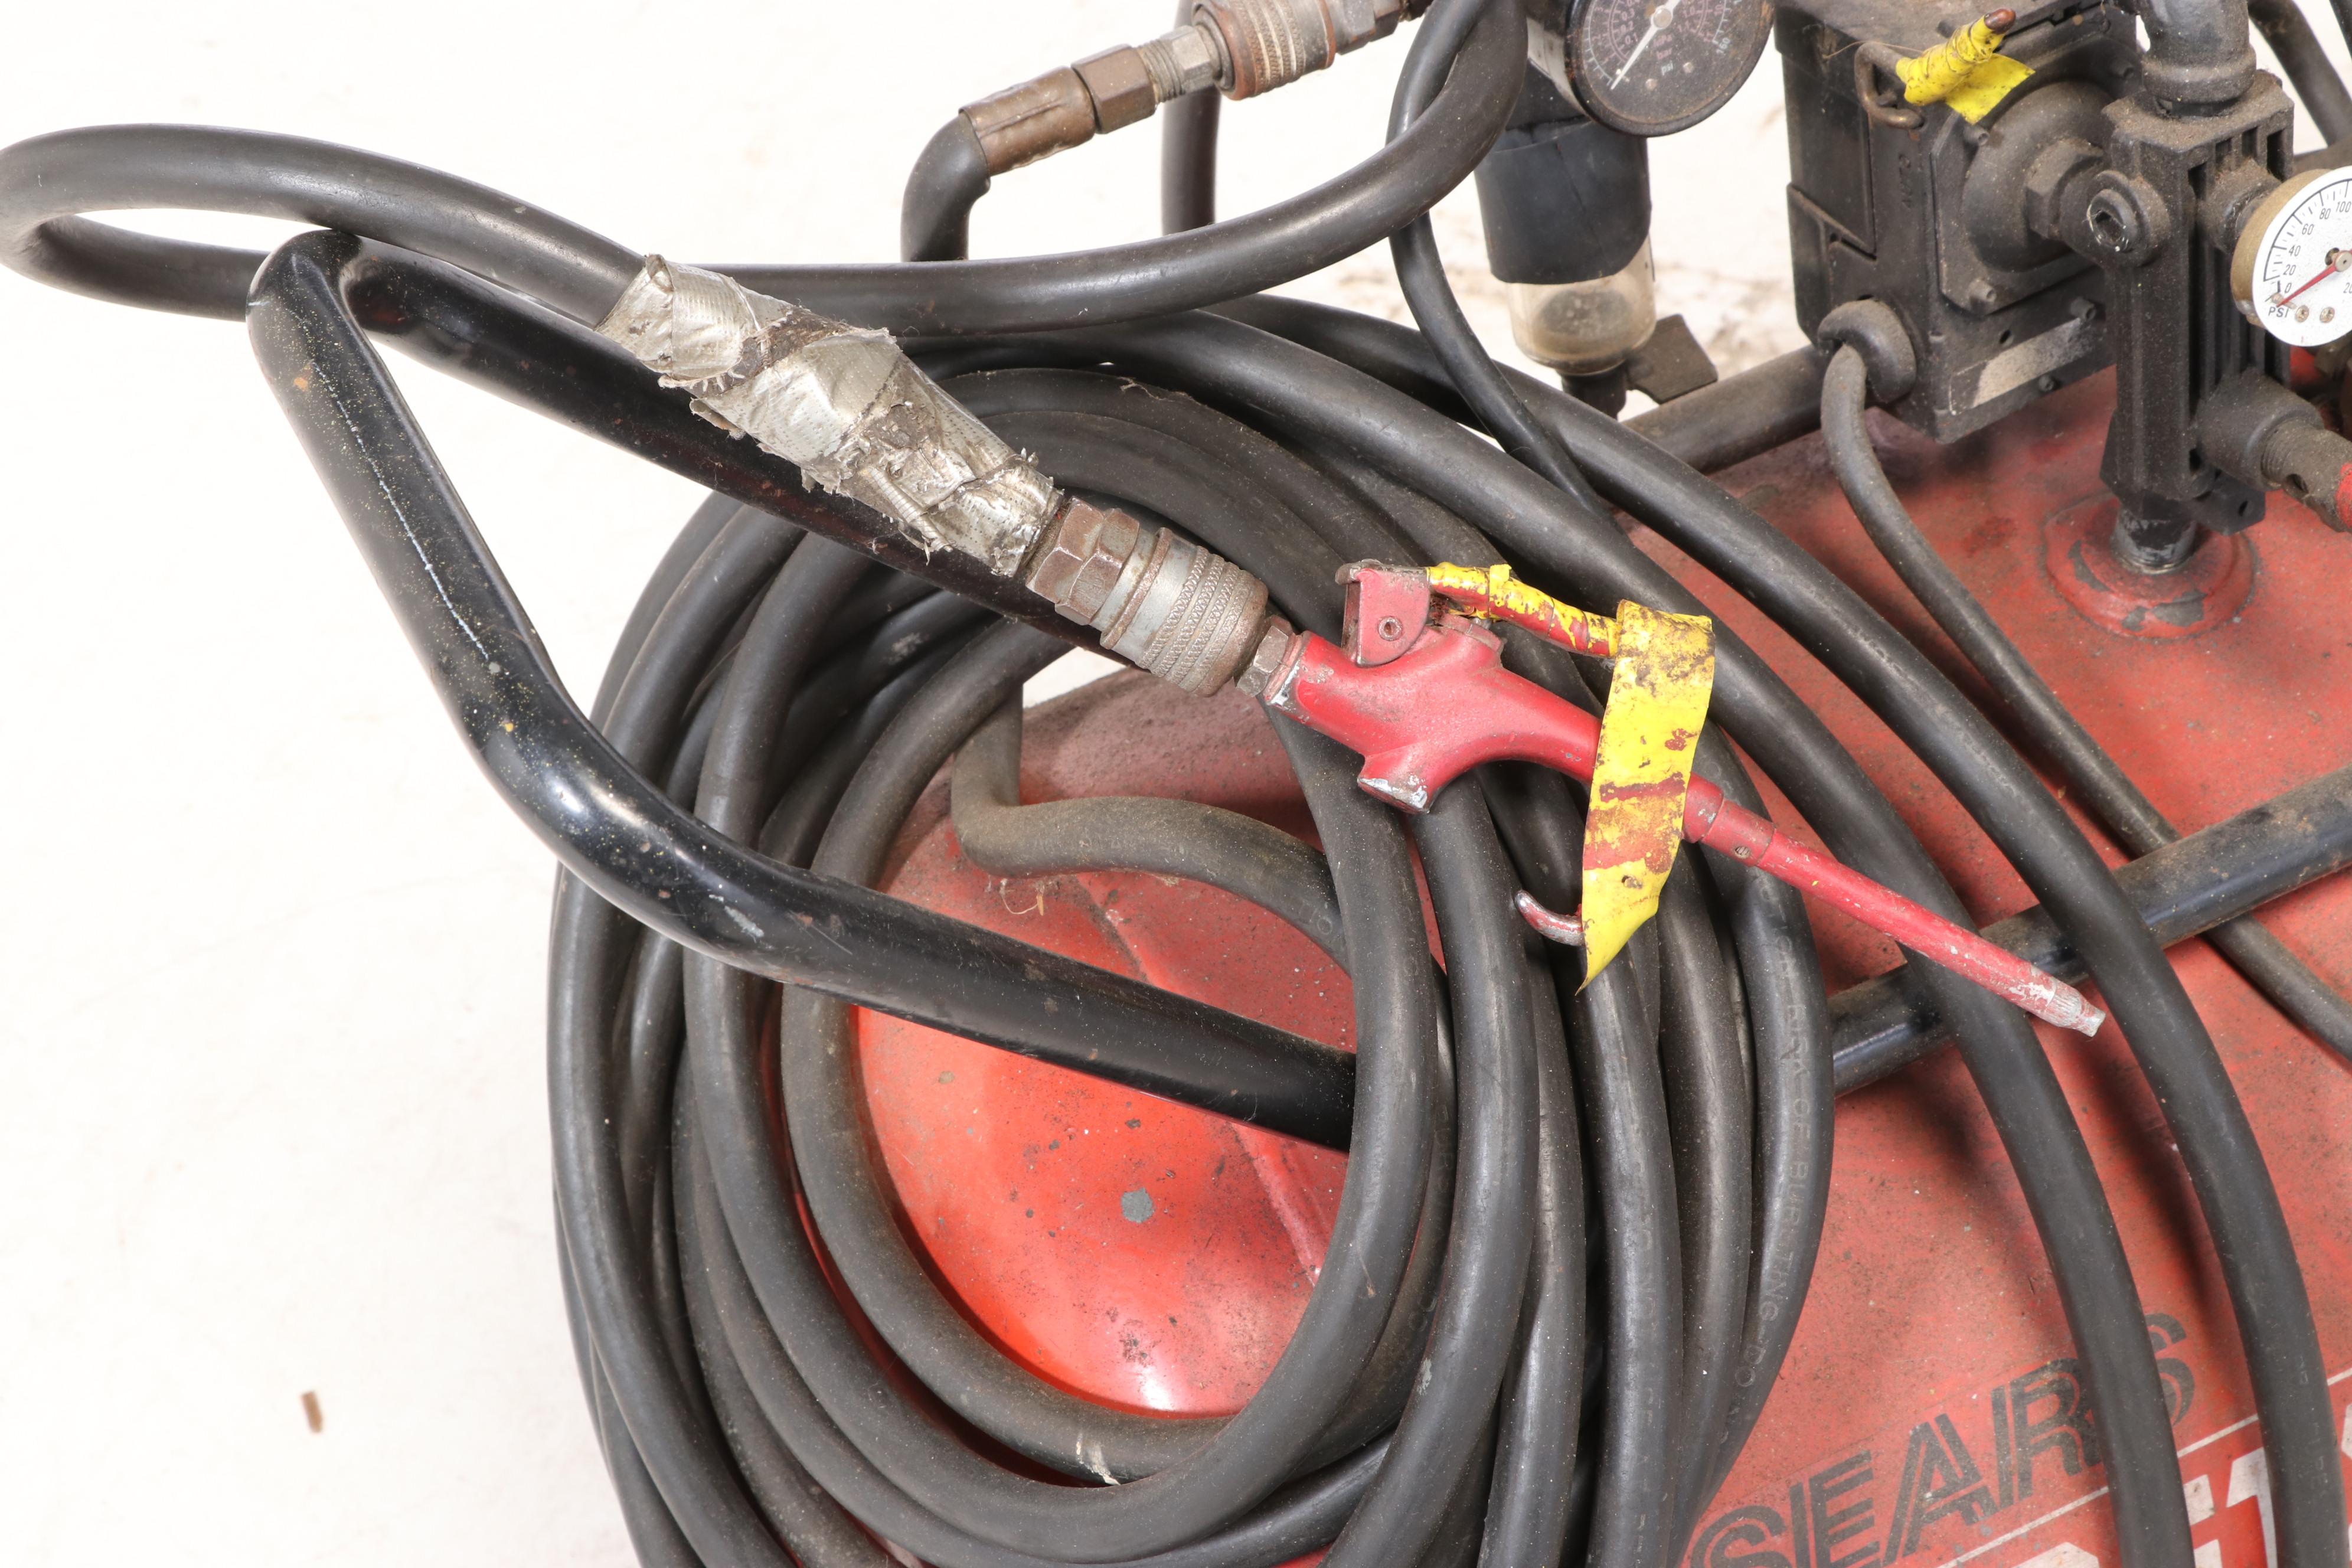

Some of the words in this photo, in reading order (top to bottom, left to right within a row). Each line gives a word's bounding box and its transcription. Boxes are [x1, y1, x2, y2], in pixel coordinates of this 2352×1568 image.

[1621, 8, 1635, 21] 0.3
[1625, 32, 1638, 45] 0.1
[1657, 48, 1672, 60] bar
[1661, 60, 1674, 76] psi
[2335, 201, 2351, 213] 100
[2319, 208, 2331, 220] 80
[2302, 223, 2315, 236] 60
[2288, 245, 2301, 257] 40
[2283, 264, 2297, 276] 20
[2284, 282, 2292, 294] 0
[2268, 306, 2289, 319] PSI
